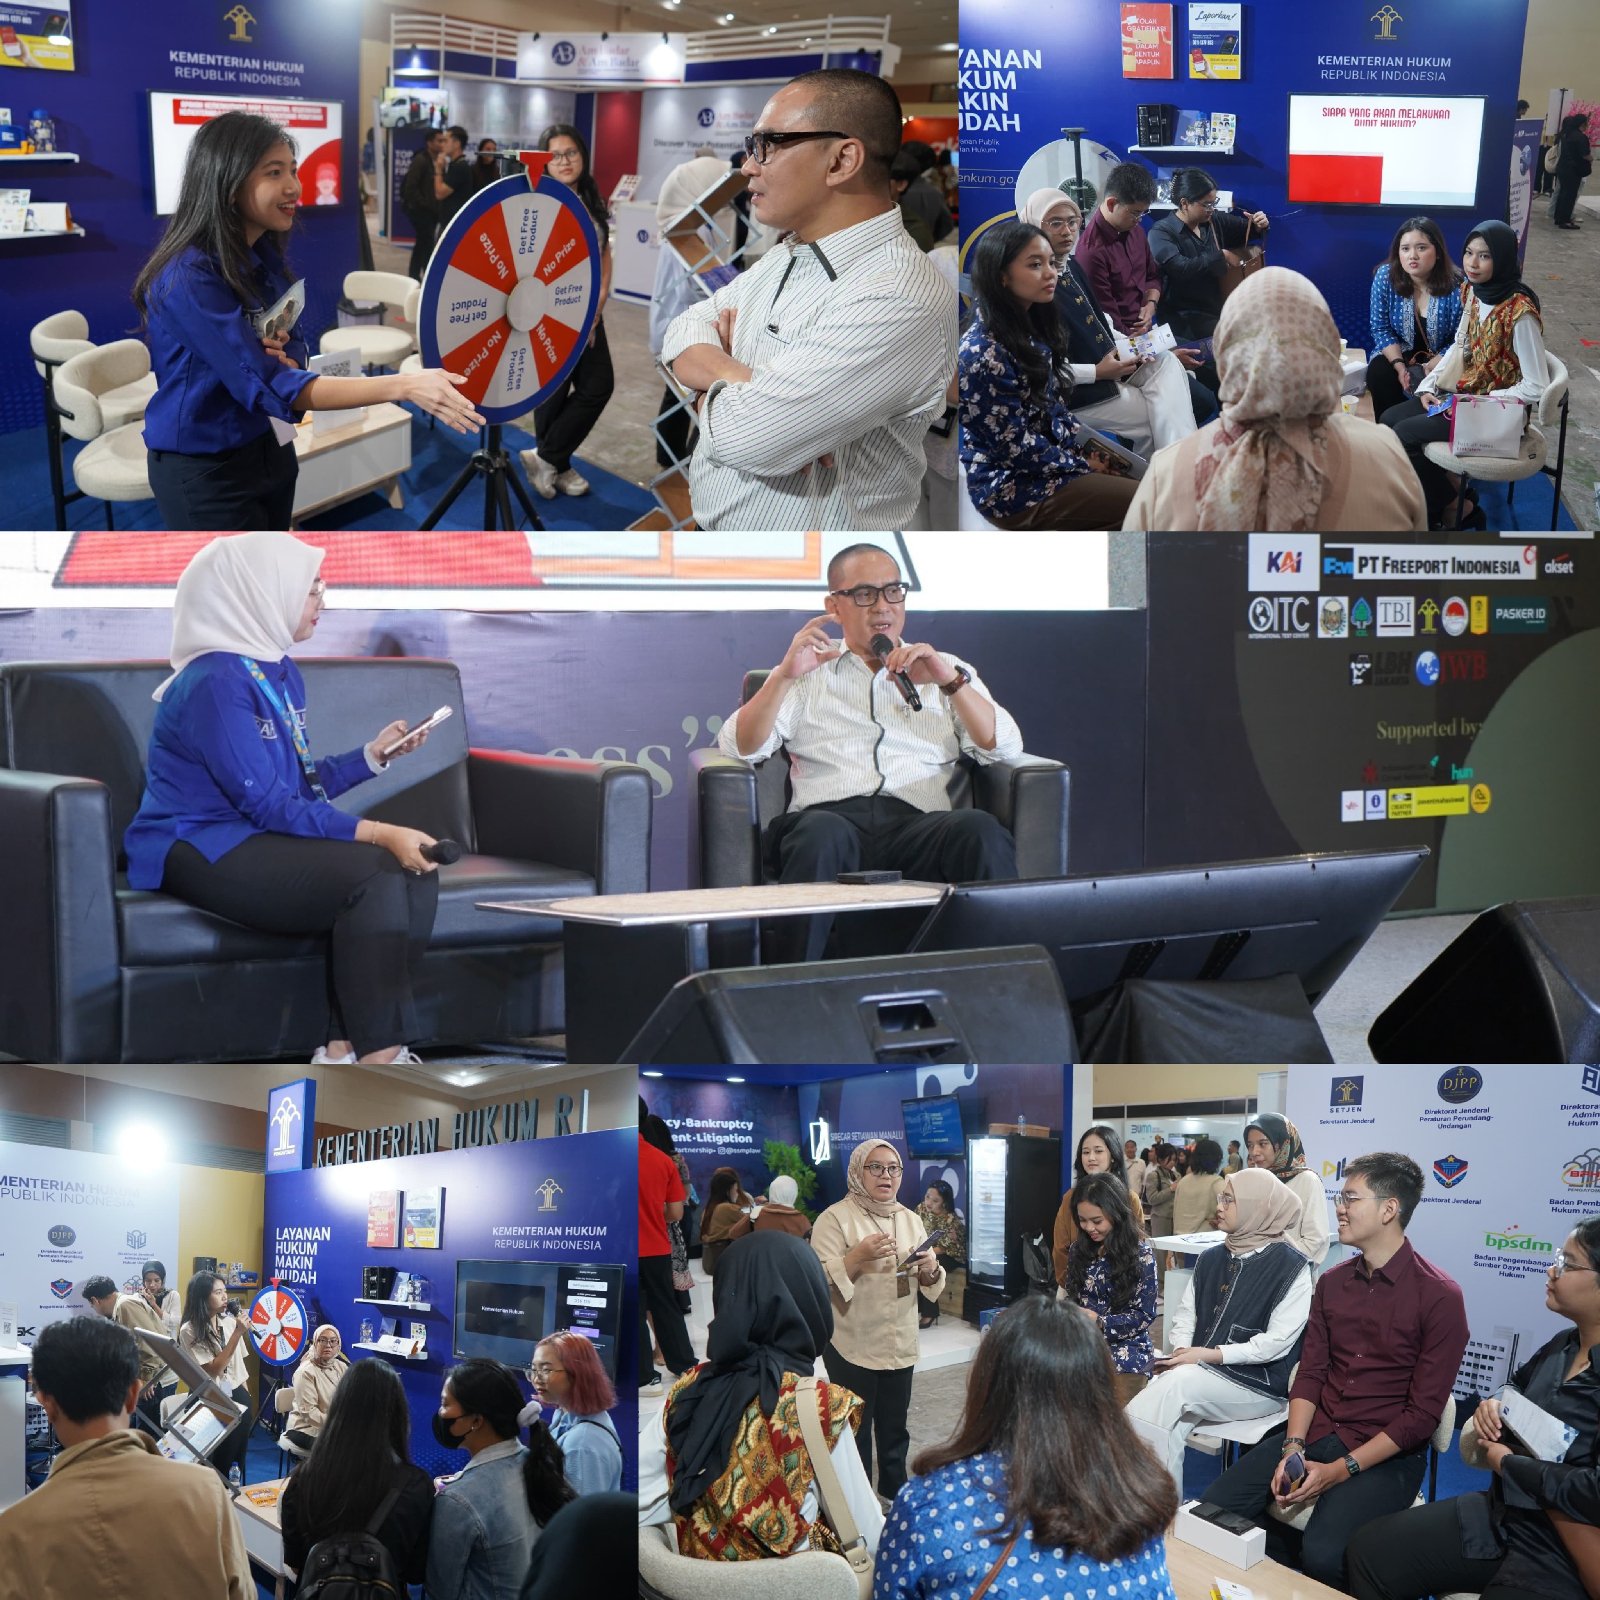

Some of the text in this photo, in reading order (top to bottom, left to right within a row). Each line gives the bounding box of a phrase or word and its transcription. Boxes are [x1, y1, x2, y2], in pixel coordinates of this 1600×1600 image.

[1195, 11, 1237, 22] Laporkan!
[169, 50, 304, 74] KEMENTERIAN HUKUM
[959, 48, 1042, 69] ANAN
[1317, 55, 1452, 68] KEMENTERIAN HUKUM
[174, 66, 301, 87] REPUBLIK INDONESIA
[1321, 69, 1447, 82] REPUBLIK INDONESIA
[1322, 107, 1450, 119] SIAPA YANG AKAN MELAKUKAN
[653, 139, 744, 149] Discover Your Potential
[978, 138, 1000, 146] Publik
[518, 208, 530, 255] Get Free
[528, 209, 538, 253] Product
[479, 232, 509, 280] No Prize
[543, 238, 576, 277] No Prize
[555, 284, 582, 296] Get Free
[452, 298, 488, 312] Product
[555, 295, 581, 306] Product
[449, 311, 487, 324] Get Free
[537, 323, 558, 364] No Prize
[463, 330, 502, 377] No Prize
[507, 350, 518, 392] Product
[515, 347, 526, 391] Get Free
[1358, 556, 1521, 575] PT FREEPORT INDONESIA
[1545, 559, 1574, 574] akset
[1380, 602, 1412, 623] TBI
[1496, 608, 1545, 620] PASKER ID
[1376, 718, 1456, 745] Supported
[1443, 1077, 1478, 1090] DJPP
[1453, 1114, 1494, 1122] Perundang-
[316, 1088, 590, 1169] KEMENTERIAN HUKUM RI
[880, 1130, 904, 1140] MANALU
[726, 1147, 761, 1155] @ssmplaw
[1, 1187, 135, 1208] PUBLIK INDONESIA
[90, 1184, 141, 1198] HUKUM
[51, 1231, 73, 1240] DJPP
[276, 1227, 331, 1241] LAYANAN
[492, 1226, 607, 1238] KEMENTERIAN HUKUM
[276, 1242, 317, 1255] HUKUM
[494, 1239, 602, 1251] REPUBLIK INDONESIA
[1485, 1234, 1553, 1252] bpsdm
[275, 1256, 313, 1269] MAKIN
[1474, 1254, 1496, 1262] Badan
[1473, 1261, 1501, 1269] Sumber
[1502, 1263, 1521, 1272] Daya
[275, 1269, 317, 1284] MUDAH
[1499, 1270, 1526, 1279] Hukum
